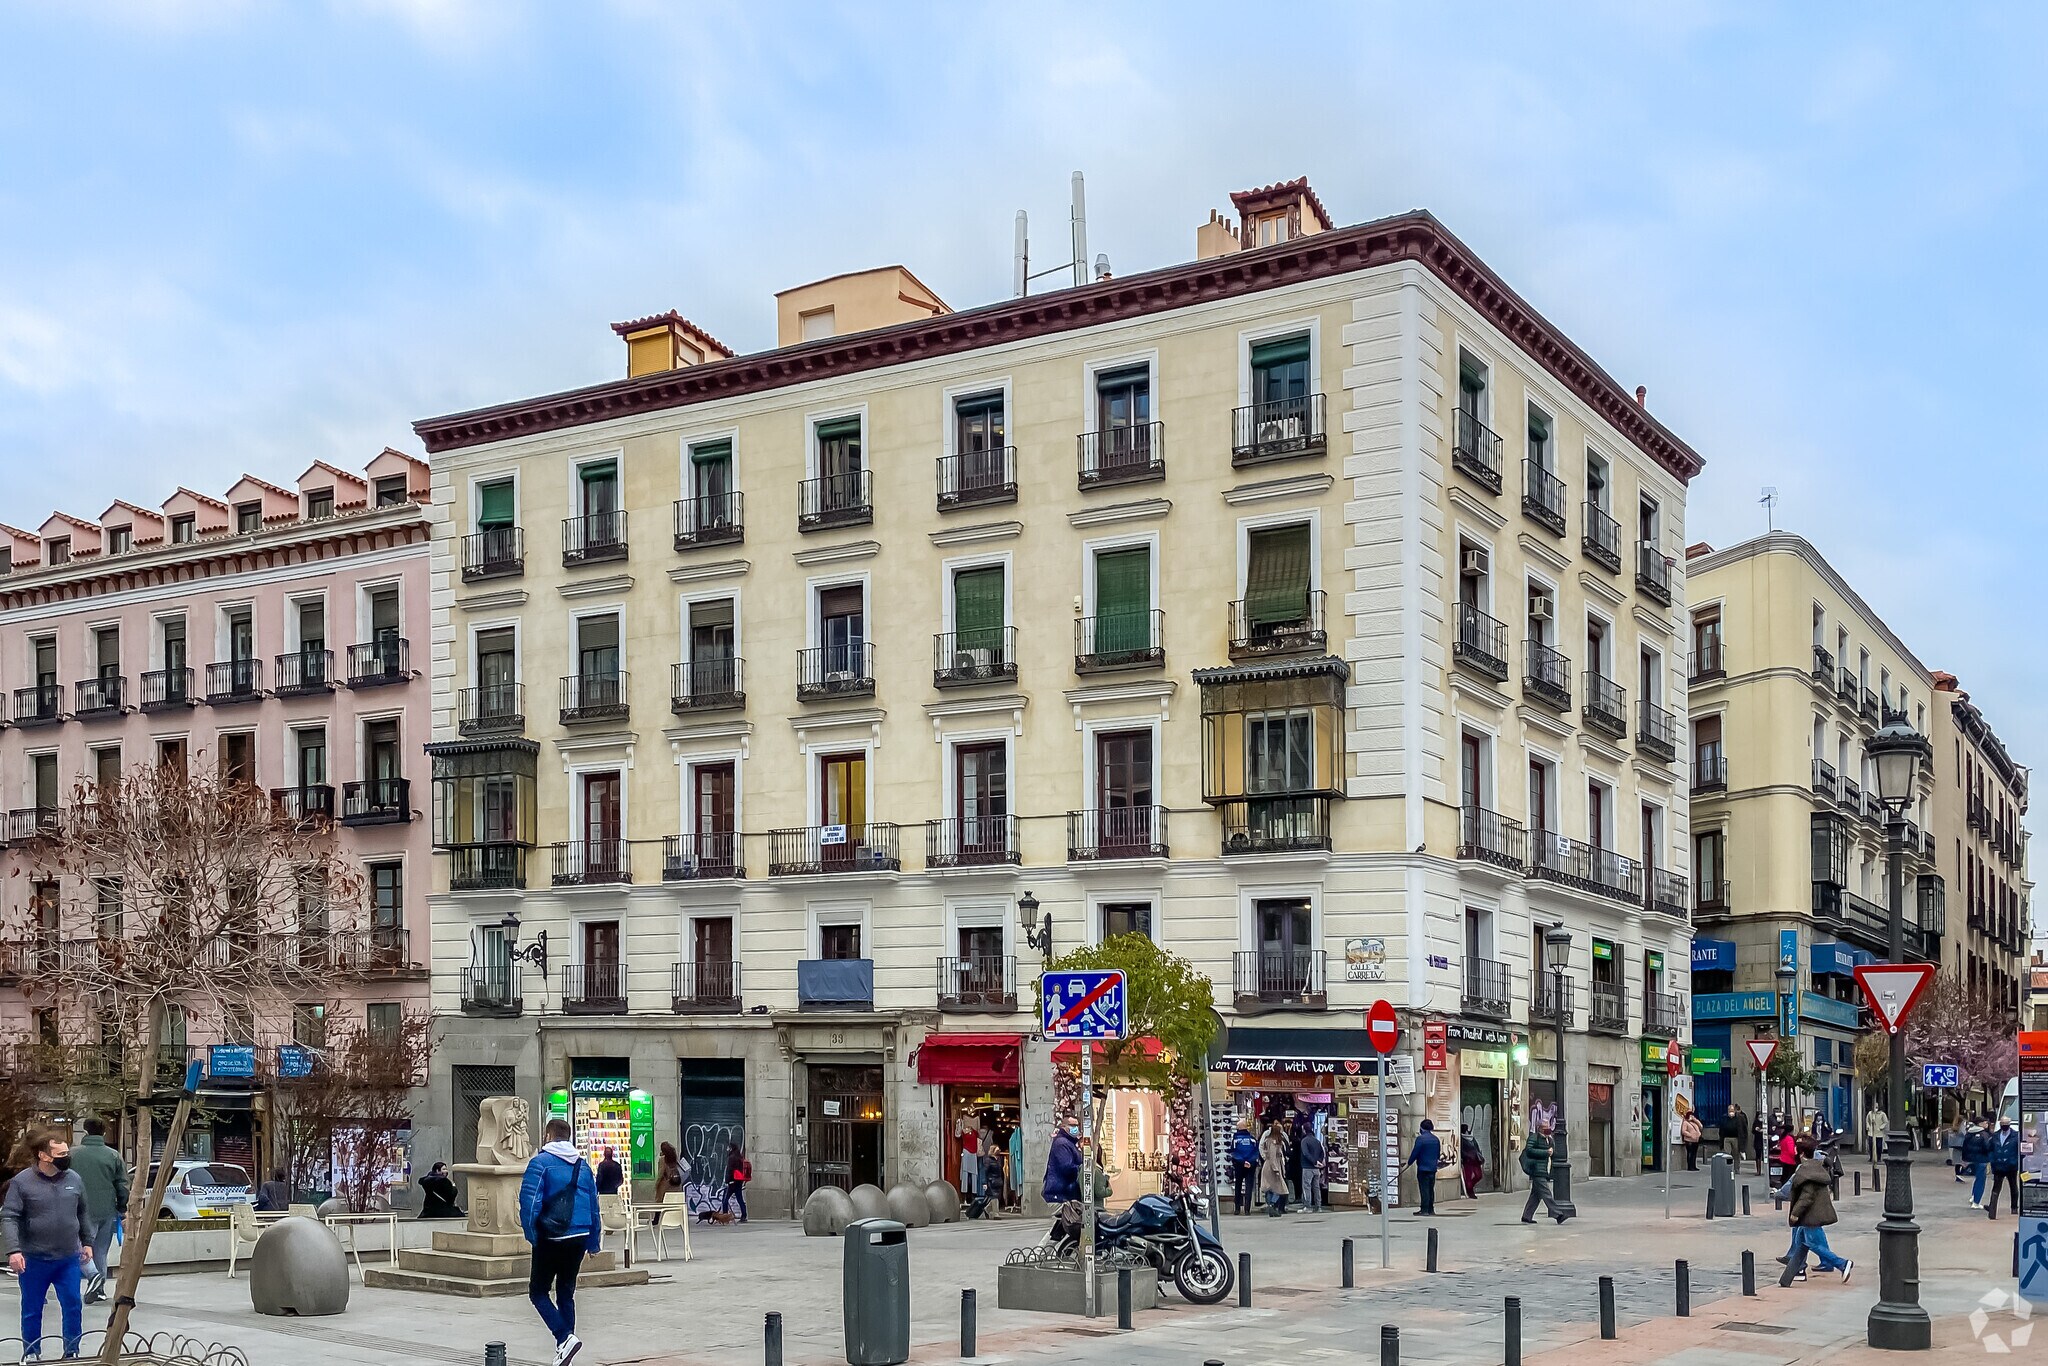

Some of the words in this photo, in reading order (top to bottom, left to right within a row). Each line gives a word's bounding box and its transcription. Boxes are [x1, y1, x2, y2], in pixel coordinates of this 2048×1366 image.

[1350, 963, 1371, 971] CALLE
[1347, 970, 1384, 980] CARRETAS
[1696, 1000, 1721, 1013] PLAZA
[1724, 998, 1740, 1012] DEL
[1743, 996, 1771, 1012] ANGEL
[832, 1033, 844, 1044] 33
[1447, 1025, 1461, 1038] From
[1462, 1027, 1483, 1042] Madrid
[1485, 1031, 1496, 1043] with
[1235, 1058, 1276, 1072] Madrid
[1284, 1060, 1308, 1073] with
[571, 1079, 630, 1093] CARCASAS
